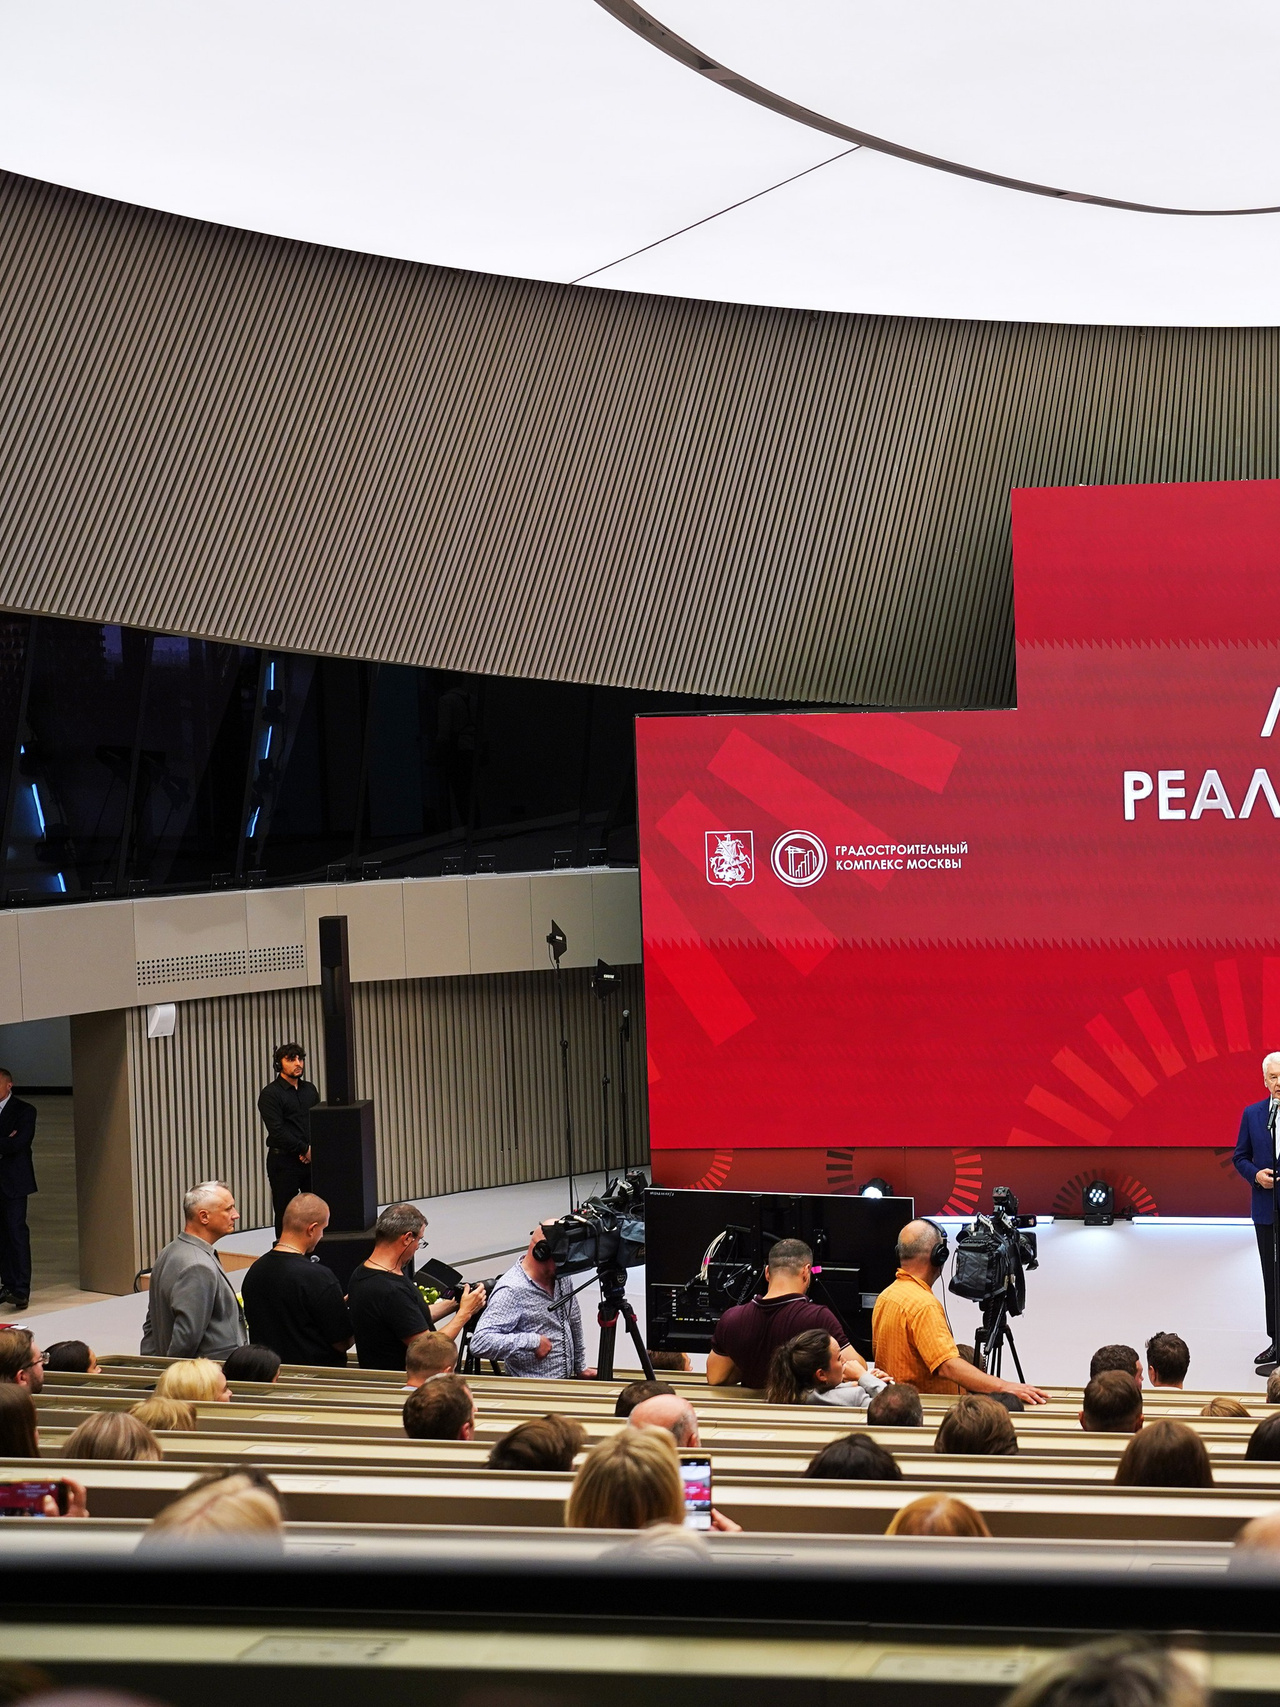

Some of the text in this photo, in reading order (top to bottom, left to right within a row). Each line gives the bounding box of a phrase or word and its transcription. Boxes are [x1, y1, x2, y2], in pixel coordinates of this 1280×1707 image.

[835, 841, 968, 857] ГРАДОСТРОИТЕЛЬНЫЙ
[836, 858, 962, 871] КОМПЛЕКС МОСКВЫ
